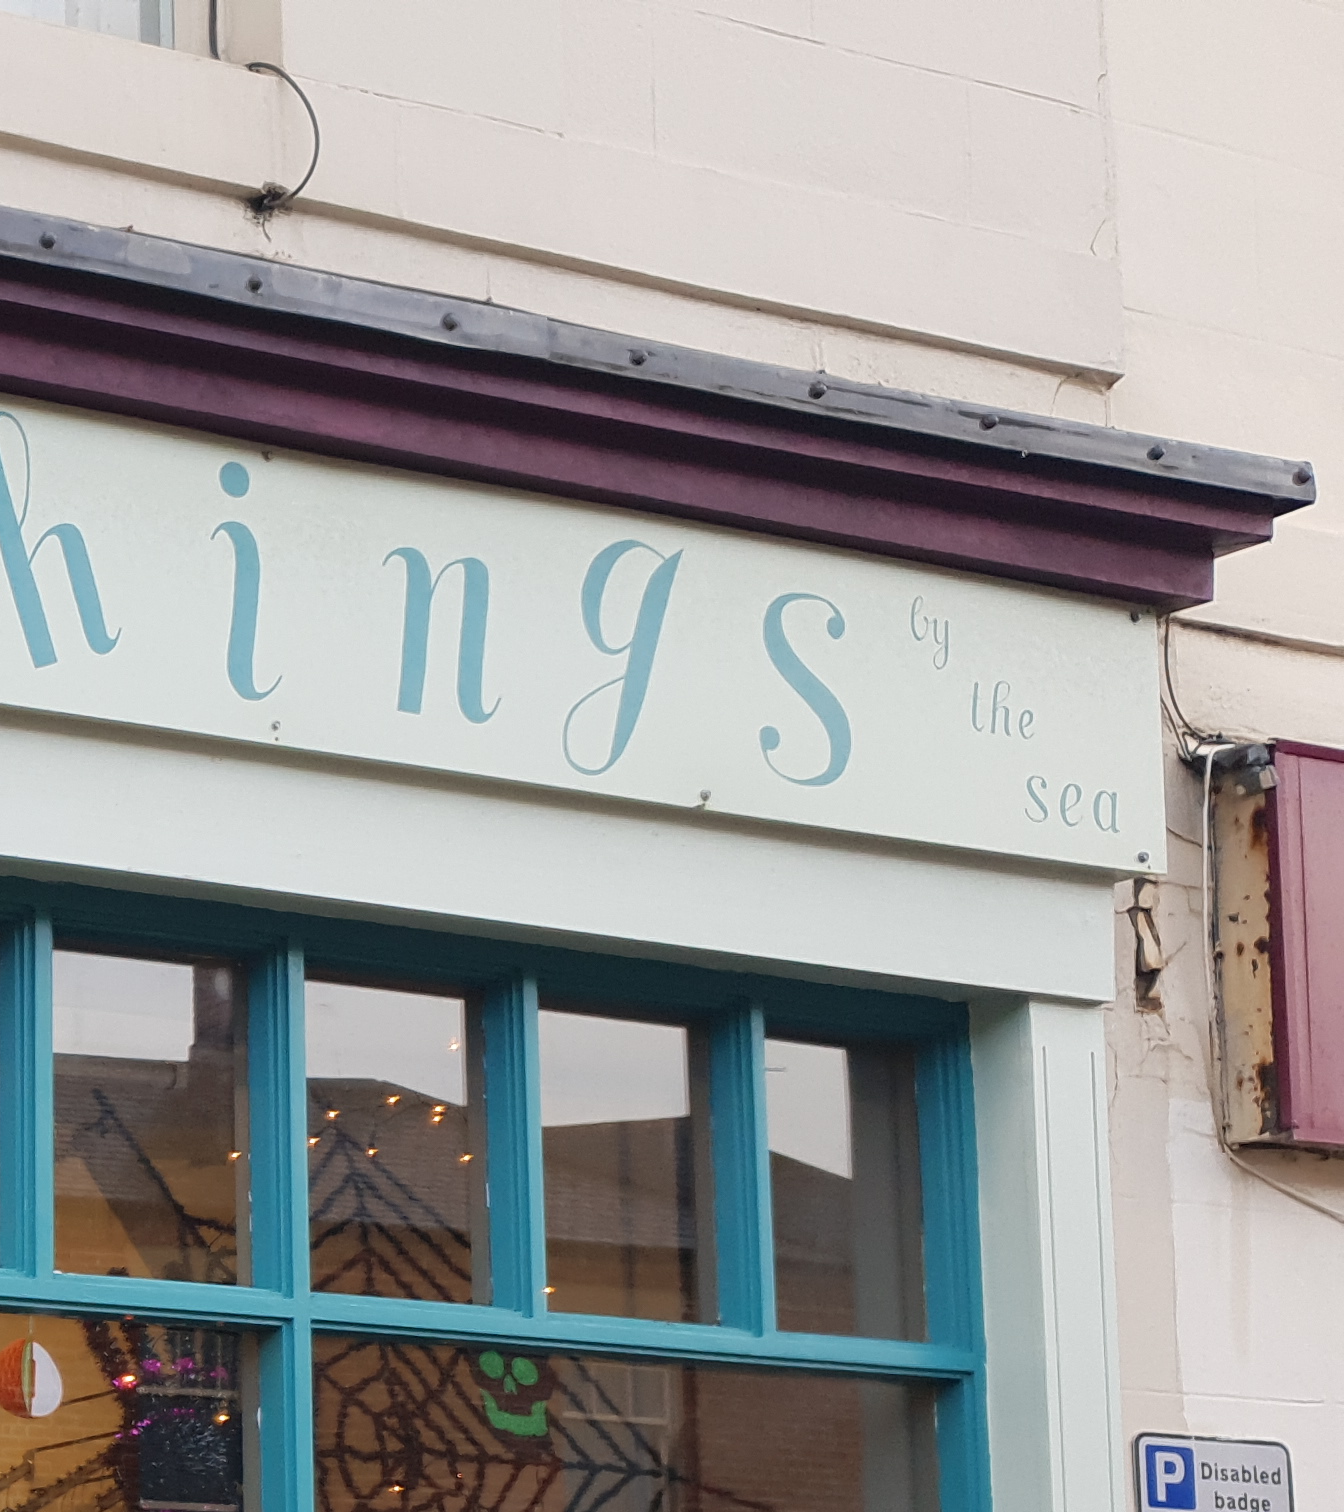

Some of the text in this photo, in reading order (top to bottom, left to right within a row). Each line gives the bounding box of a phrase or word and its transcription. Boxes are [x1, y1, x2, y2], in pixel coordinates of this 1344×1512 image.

[909, 593, 951, 671] by
[968, 680, 1035, 740] the
[1024, 773, 1121, 836] sea
[1200, 1461, 1282, 1485] Disabled
